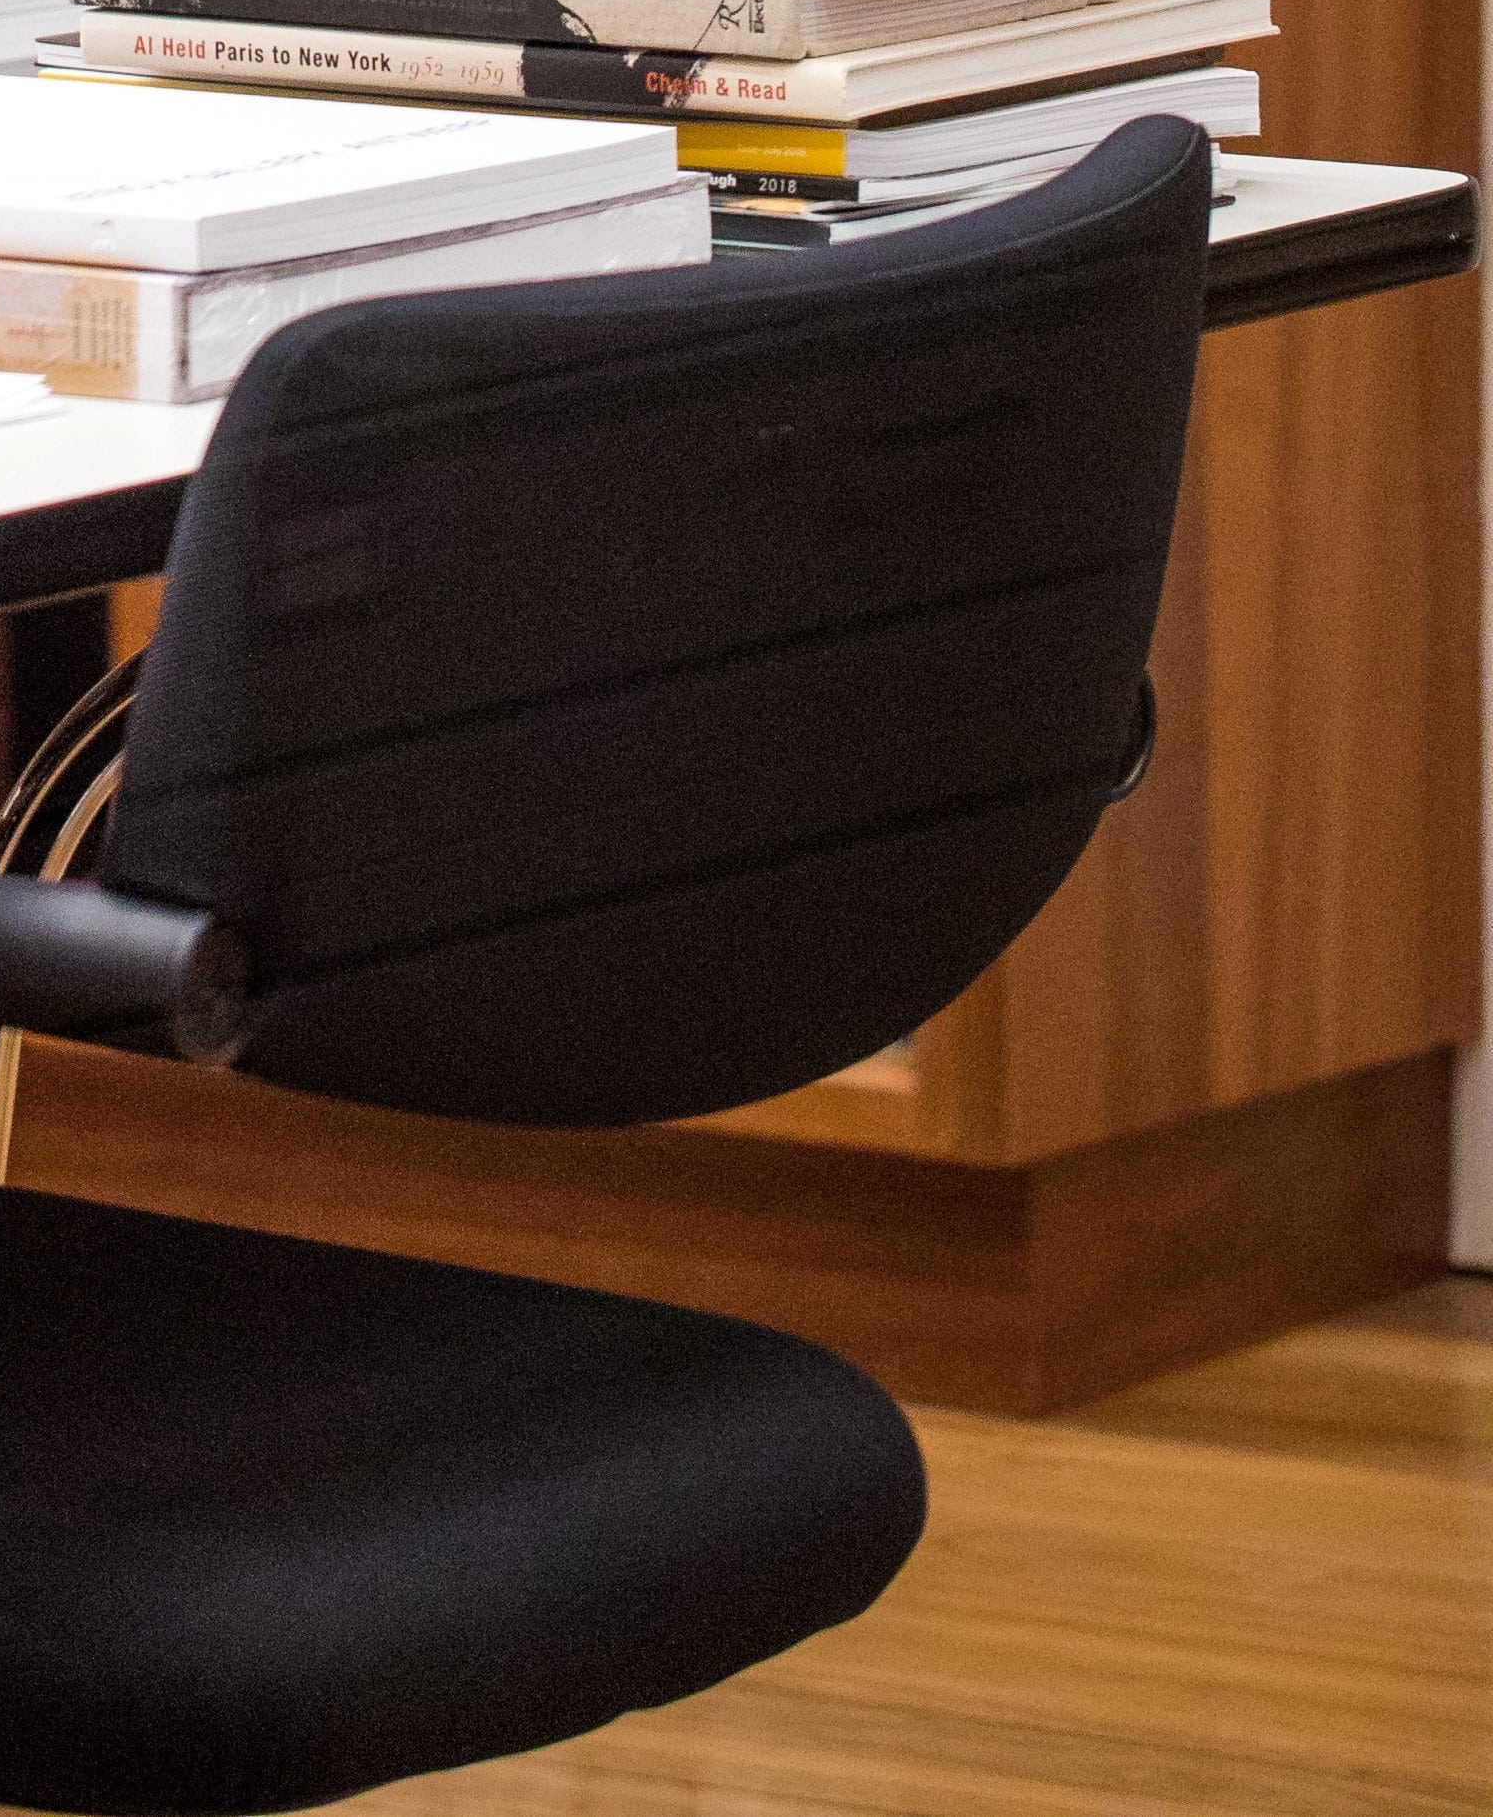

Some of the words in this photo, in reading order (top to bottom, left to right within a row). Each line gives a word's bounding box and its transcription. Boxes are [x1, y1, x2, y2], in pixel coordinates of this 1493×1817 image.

[134, 35, 153, 55] Al
[162, 37, 206, 59] Held
[214, 40, 264, 64] Paris
[272, 44, 291, 64] to
[298, 46, 340, 68] New
[347, 50, 392, 72] York
[715, 76, 728, 97] &
[737, 78, 788, 100] Read
[758, 177, 798, 194] 2018
